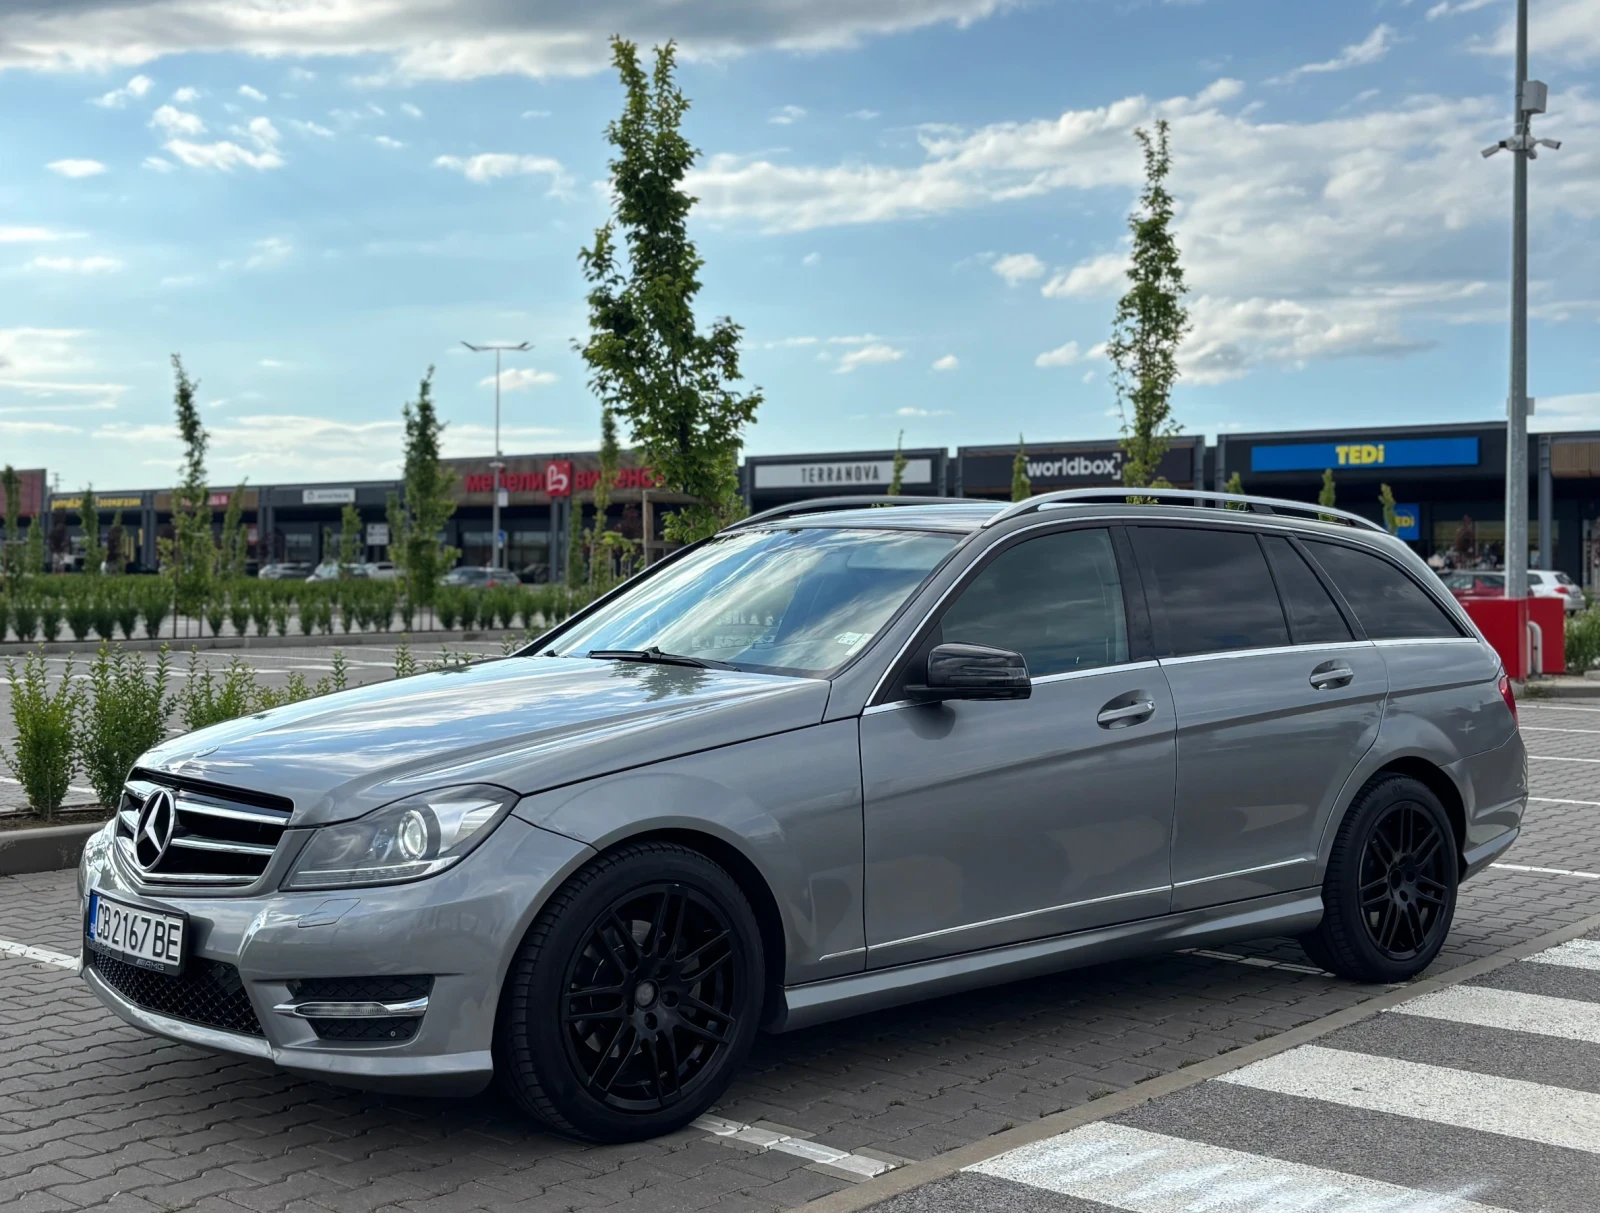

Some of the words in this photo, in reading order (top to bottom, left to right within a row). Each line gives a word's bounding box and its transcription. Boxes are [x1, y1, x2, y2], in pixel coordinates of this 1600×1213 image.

[1335, 444, 1385, 465] TEDi
[801, 464, 879, 483] TERRANOVA
[1026, 457, 1116, 477] worldbox
[575, 467, 665, 489] виено
